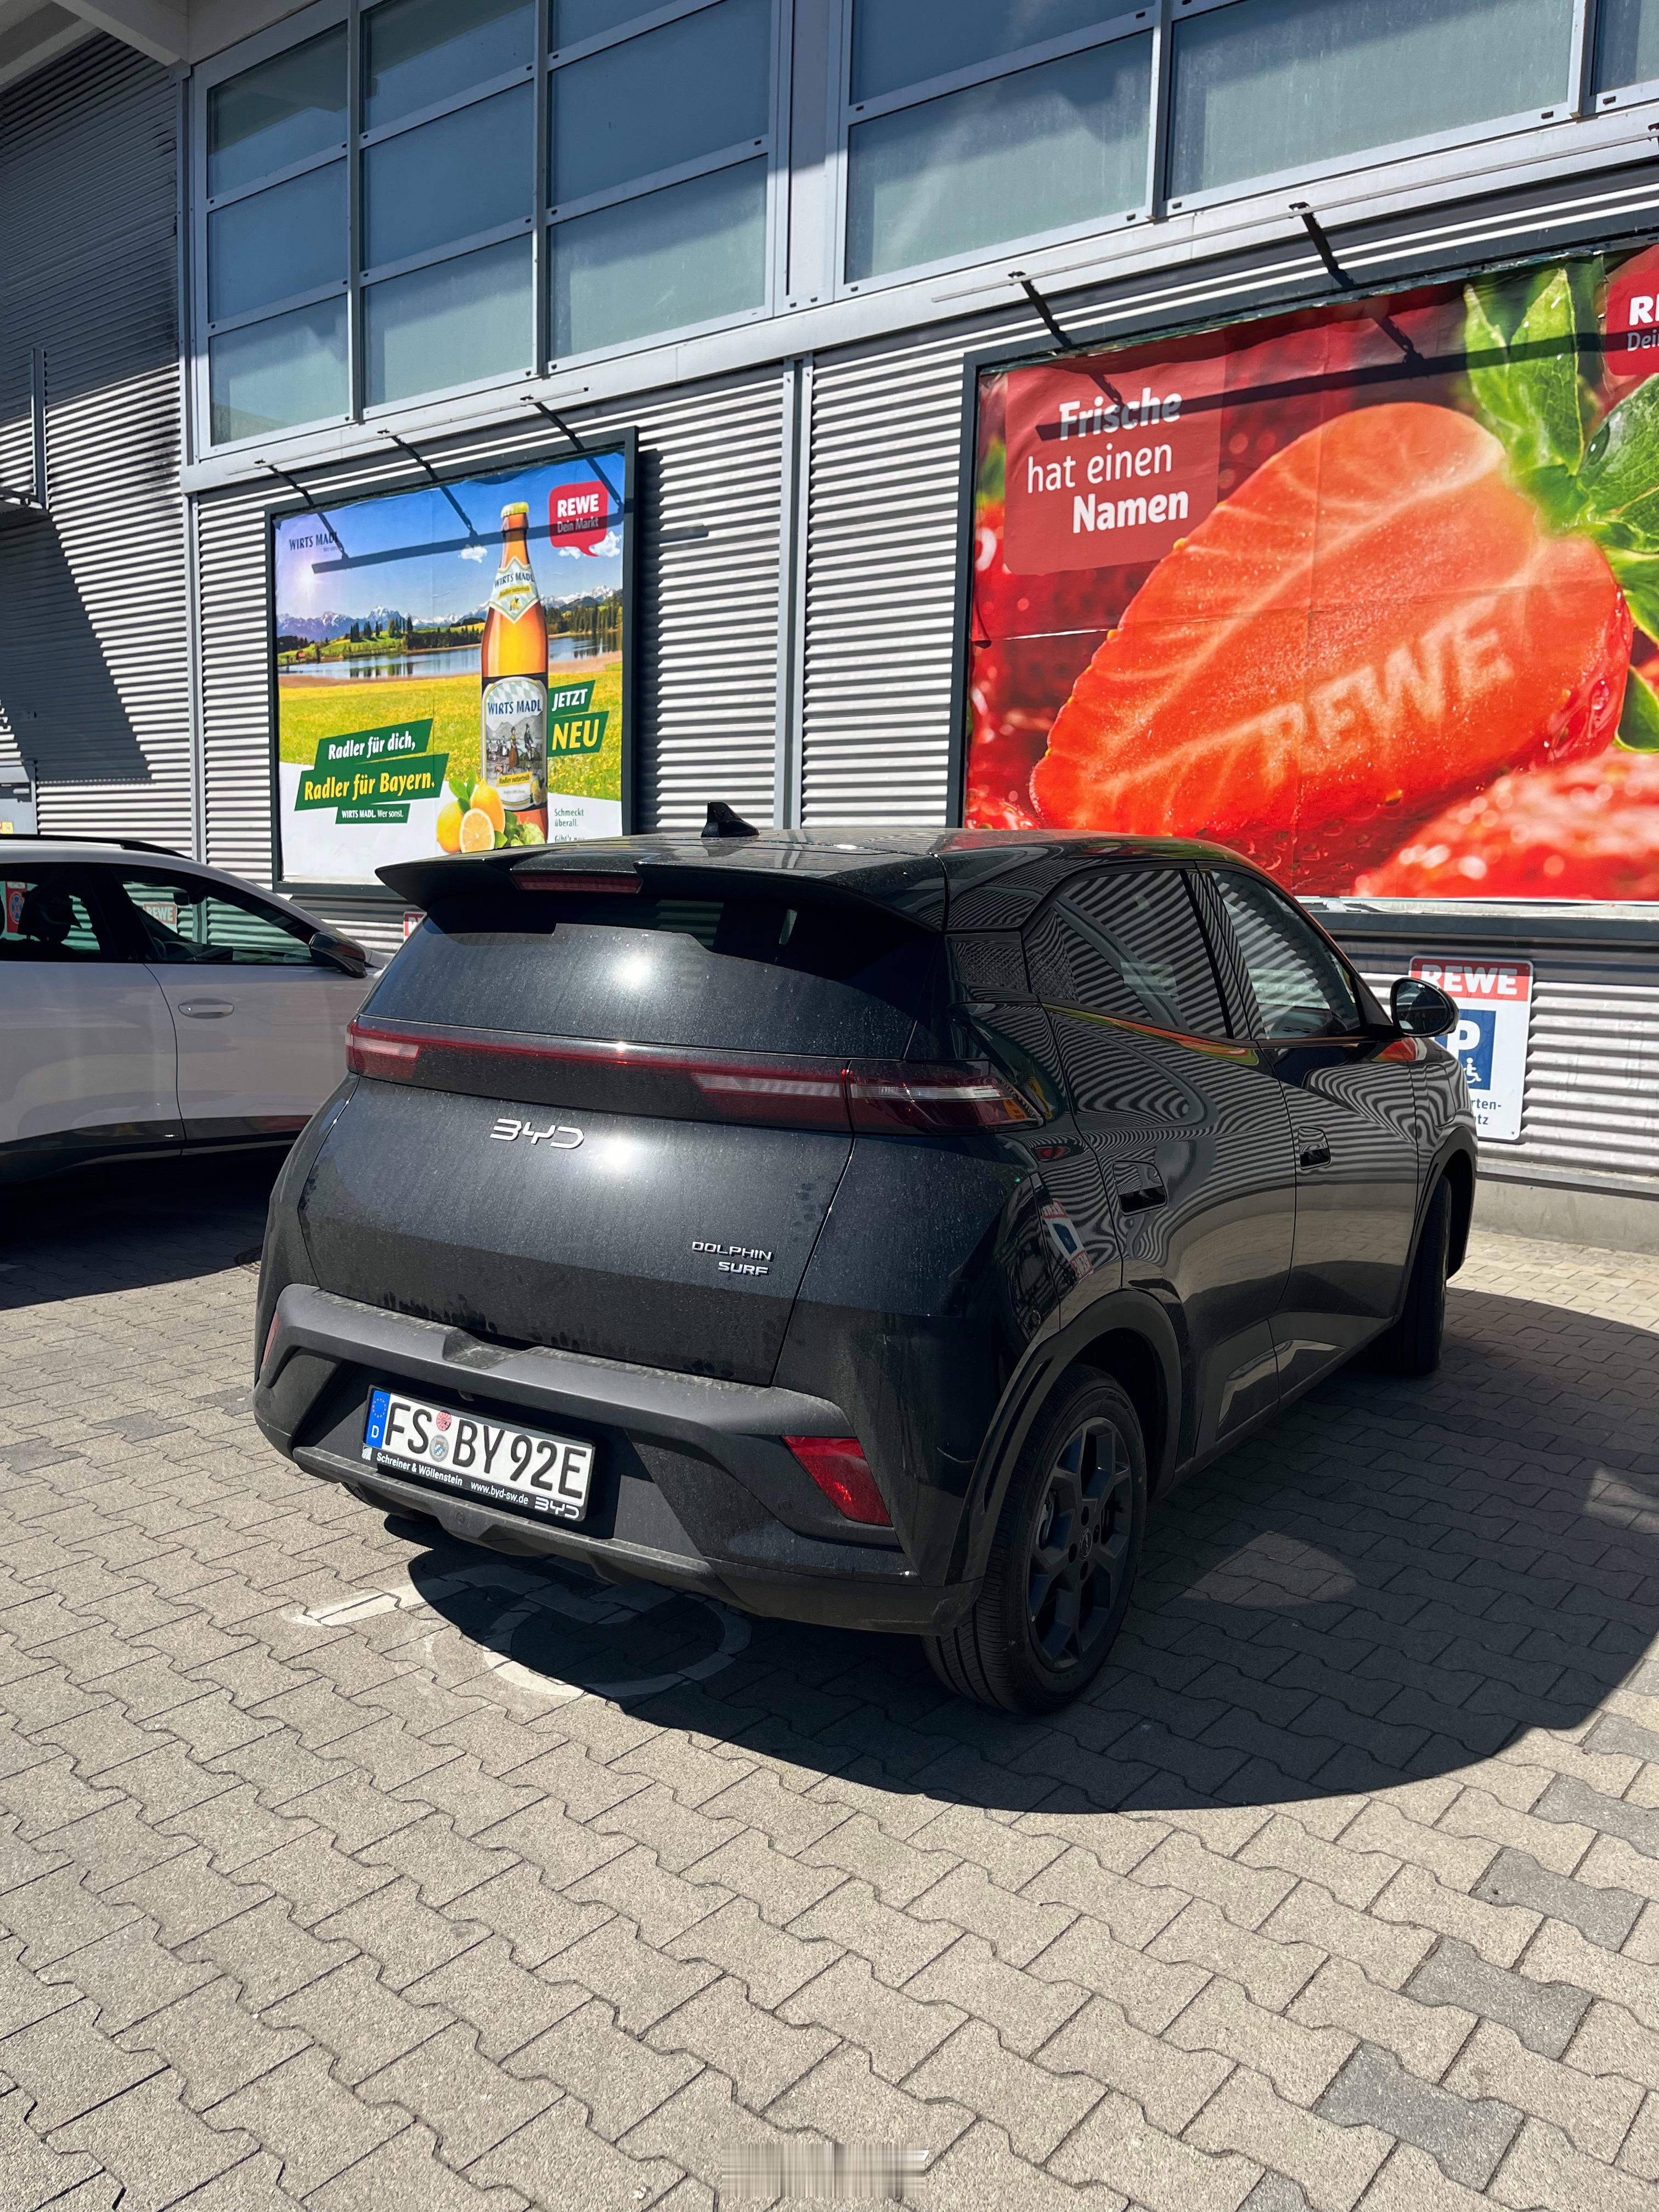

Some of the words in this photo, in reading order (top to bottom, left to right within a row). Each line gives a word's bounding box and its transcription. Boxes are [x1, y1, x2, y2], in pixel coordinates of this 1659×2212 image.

[1629, 294, 1659, 326] R
[1627, 329, 1659, 351] Dei
[1059, 386, 1183, 441] Frische
[1028, 455, 1076, 493] hat
[1087, 443, 1172, 484] einen
[557, 494, 599, 517] REWE
[1073, 490, 1189, 534] Namen
[557, 520, 573, 533] Dein
[575, 516, 599, 530] Markt
[289, 536, 313, 550] WIRTS
[551, 689, 588, 712] JETZT
[1261, 595, 1515, 787] REWE
[487, 699, 514, 715] WIRTS
[517, 699, 542, 713] MADL
[328, 740, 365, 760] Radler
[366, 736, 385, 758] für
[387, 730, 416, 751] dich,
[551, 719, 600, 751] NEU
[304, 776, 350, 801] Radler
[352, 773, 376, 802] für
[380, 771, 435, 797] Bayern.
[342, 810, 358, 819] WIRTS
[377, 809, 388, 818] Wer
[388, 809, 404, 818] sonst.
[554, 808, 584, 816] Schmeckt
[555, 818, 579, 827] überall.
[1421, 964, 1517, 995] REWE
[490, 1118, 585, 1149] BYD
[692, 1241, 772, 1261] DOLPHIN
[718, 1261, 769, 1276] SURF
[371, 1425, 379, 1438] D
[385, 1402, 432, 1454] FS
[376, 1452, 410, 1470] Schreiner
[411, 1463, 417, 1472] &
[419, 1464, 463, 1486] Wöllenstein
[471, 1482, 529, 1505] www.byd-sw.de
[534, 1496, 579, 1519] BYD
